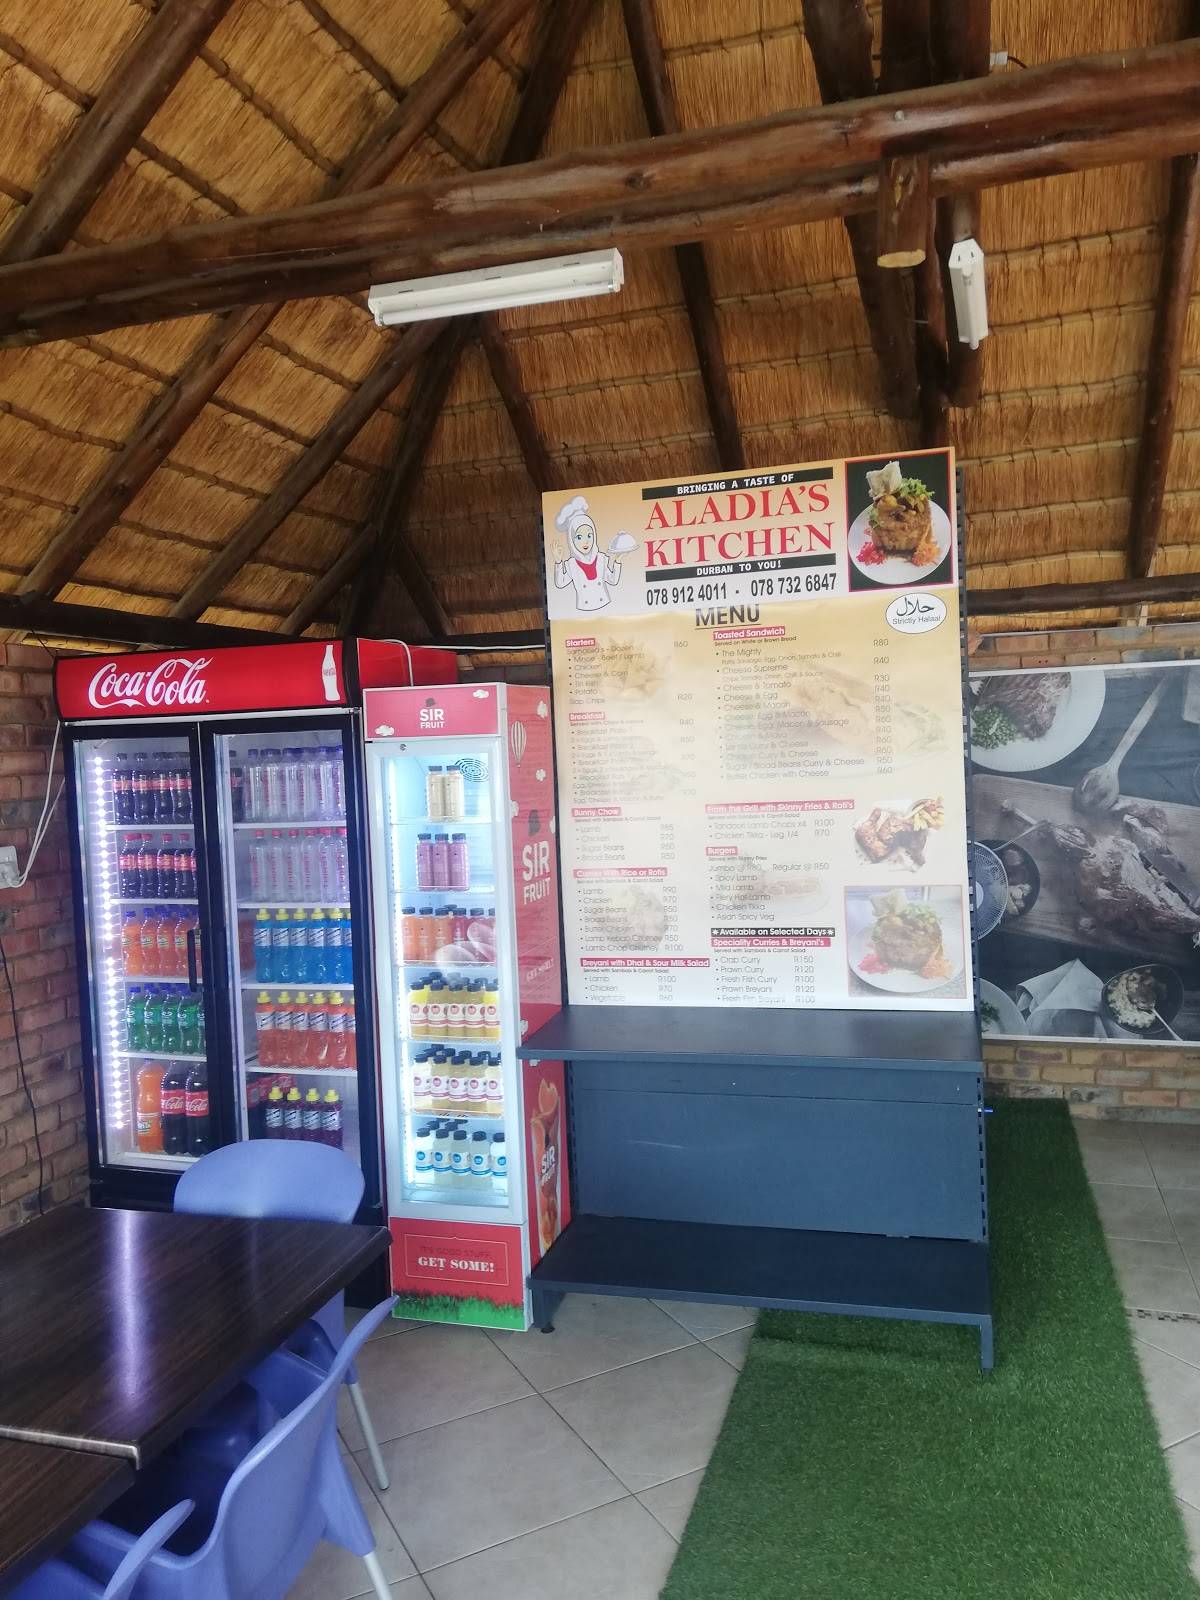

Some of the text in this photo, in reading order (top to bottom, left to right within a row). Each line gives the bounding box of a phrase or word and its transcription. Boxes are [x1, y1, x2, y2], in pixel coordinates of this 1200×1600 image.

[677, 474, 794, 495] BRINGING A TASTE OF
[645, 484, 830, 530] ALADIA'S
[644, 522, 835, 567] KITCHEN
[696, 565, 733, 576] DURBAN
[757, 560, 782, 570] YOU!
[646, 573, 837, 605] 078 912 4011 078 732 6847
[695, 603, 760, 626] MENU
[892, 616, 917, 625] Strictly
[714, 627, 785, 640] Toasted Sandwich
[566, 639, 595, 647] Starters
[873, 638, 888, 646] R80
[737, 648, 762, 657] Mighty
[754, 664, 788, 672] Supreme
[88, 656, 213, 709] Coca-Cola
[763, 681, 792, 689] Tomato
[763, 691, 778, 700] Egg
[419, 708, 445, 722] SIR
[570, 712, 605, 720] Breakfast
[420, 720, 445, 729] FRUIT
[803, 759, 824, 768] Curry
[834, 757, 865, 766] Cheese
[798, 769, 830, 778] Cheese
[777, 803, 803, 812] Skinny
[574, 807, 619, 818] Bunny Chow
[707, 847, 736, 856] Burgers
[522, 840, 550, 882] SIR
[772, 863, 801, 873] Regular
[736, 873, 758, 881] Lamb
[523, 876, 551, 905] FRUIT
[583, 888, 604, 896] Lamb
[716, 903, 747, 911] Chicken
[738, 912, 758, 922] Spicy
[758, 912, 775, 922] Veg
[720, 928, 756, 936] Available
[769, 928, 804, 936] Selected
[806, 928, 827, 937] Days
[713, 938, 751, 947] Speciality
[781, 938, 788, 946] &
[789, 938, 825, 948] Breyani's
[585, 944, 606, 952] Lamb
[607, 944, 628, 953] Chop
[582, 959, 610, 968] Breyani
[610, 959, 626, 967] with
[627, 959, 644, 967] Dhal
[687, 959, 709, 967] Salad
[741, 956, 761, 966] Curry
[793, 955, 814, 963] R150
[721, 966, 743, 974] Prawn
[744, 966, 765, 975] Curry
[757, 976, 778, 985] Curry
[794, 975, 815, 983] R100
[722, 985, 744, 993] Prawn
[418, 1256, 495, 1273] GET SOME!
